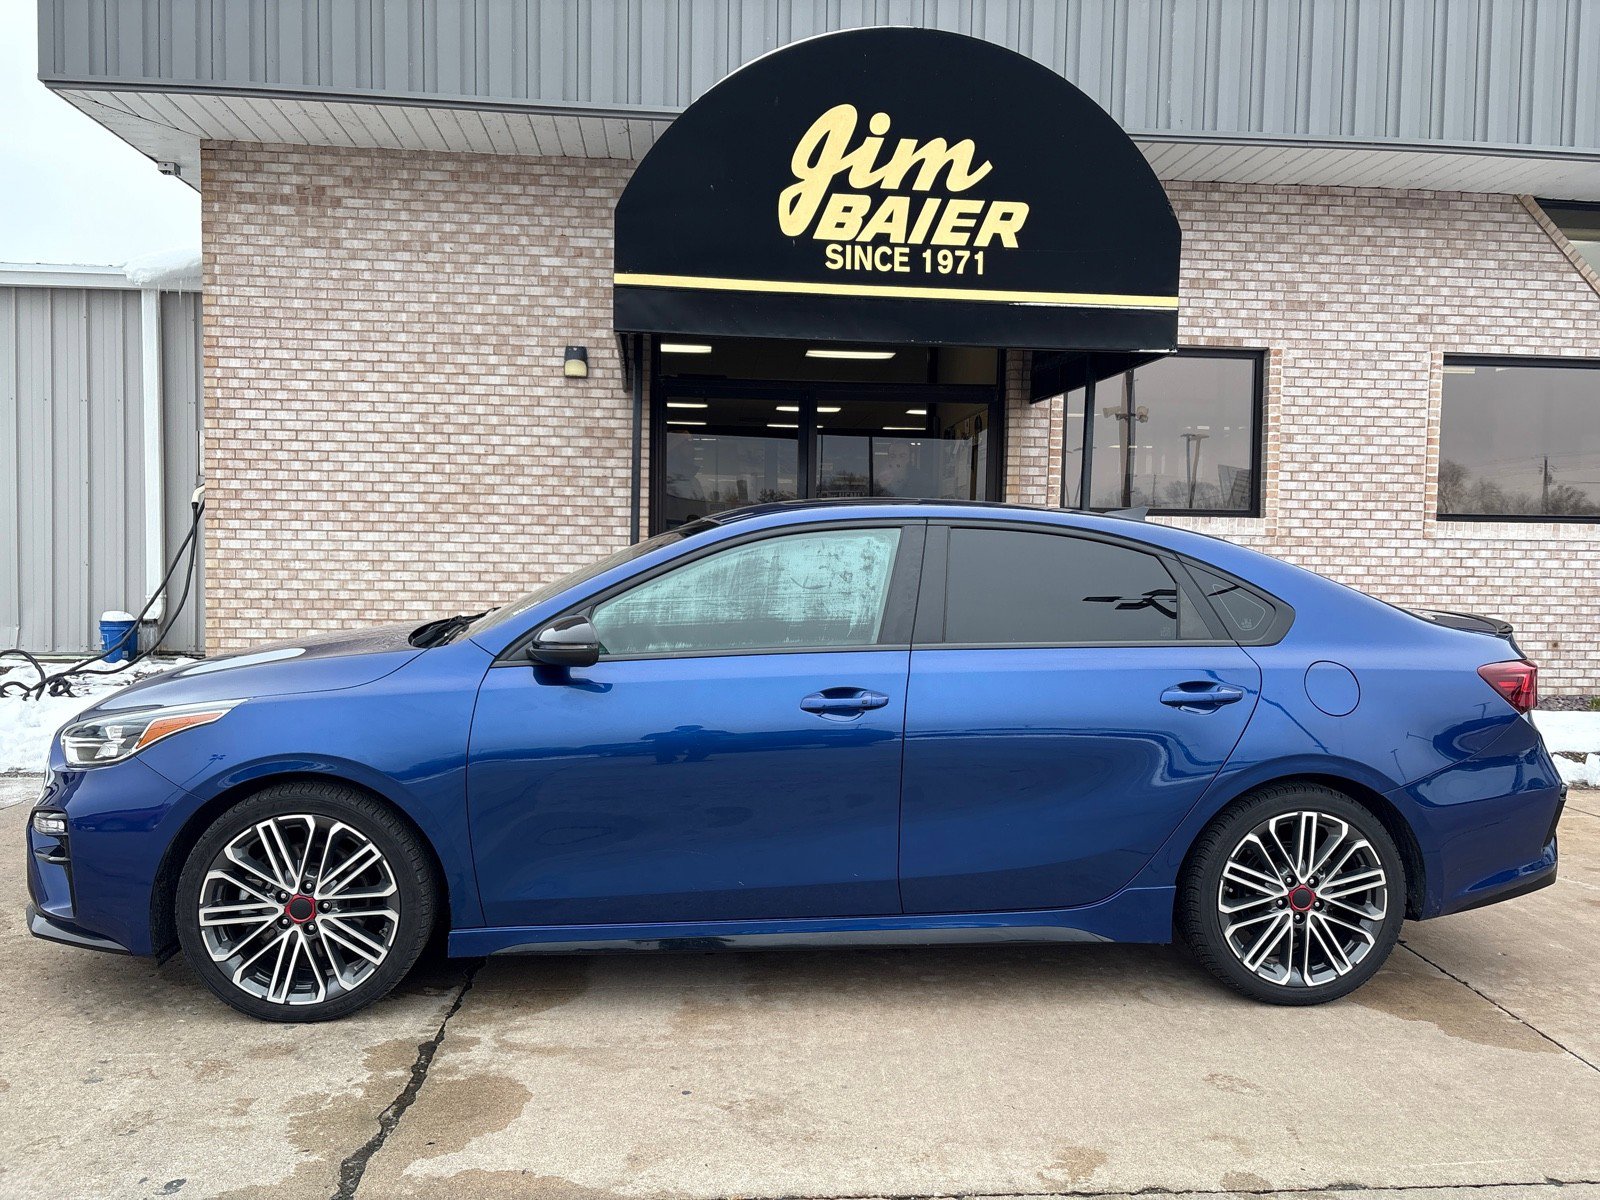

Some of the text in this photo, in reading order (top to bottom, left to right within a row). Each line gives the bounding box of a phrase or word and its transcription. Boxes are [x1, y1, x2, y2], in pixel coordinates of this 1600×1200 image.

[778, 104, 993, 236] Jim
[813, 193, 1029, 248] BAIER
[825, 244, 984, 275] SINCE 1971
